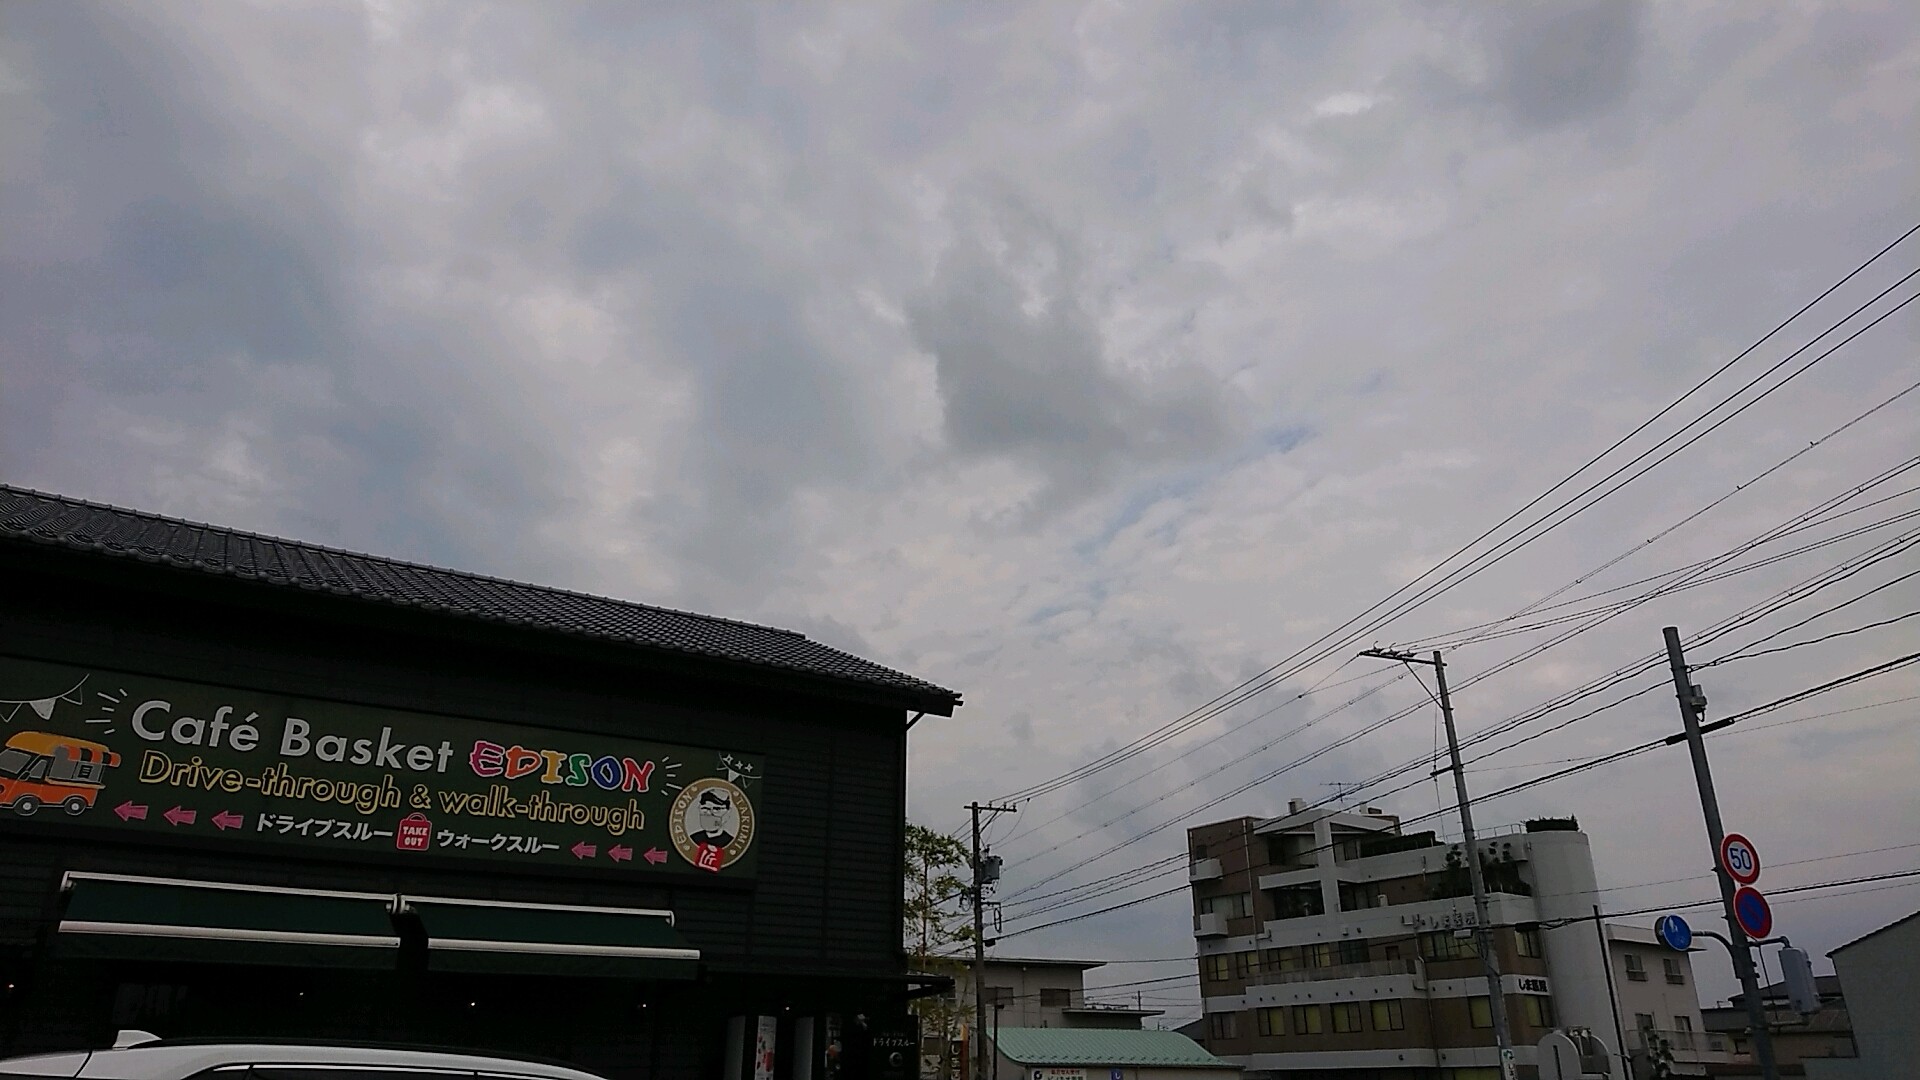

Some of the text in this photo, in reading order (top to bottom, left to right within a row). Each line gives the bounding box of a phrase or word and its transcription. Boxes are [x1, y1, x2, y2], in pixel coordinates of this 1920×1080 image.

[130, 700, 656, 793] Café Basket EDISON
[139, 750, 646, 836] Drive-through & walk-through
[256, 813, 394, 841] ドライブスルー
[402, 825, 428, 837] TAKE
[673, 791, 693, 845] EDISON
[734, 796, 752, 850] TAKUMI
[403, 837, 424, 848] OUT
[436, 830, 560, 854] ウォークスルー
[1730, 847, 1752, 870] 50
